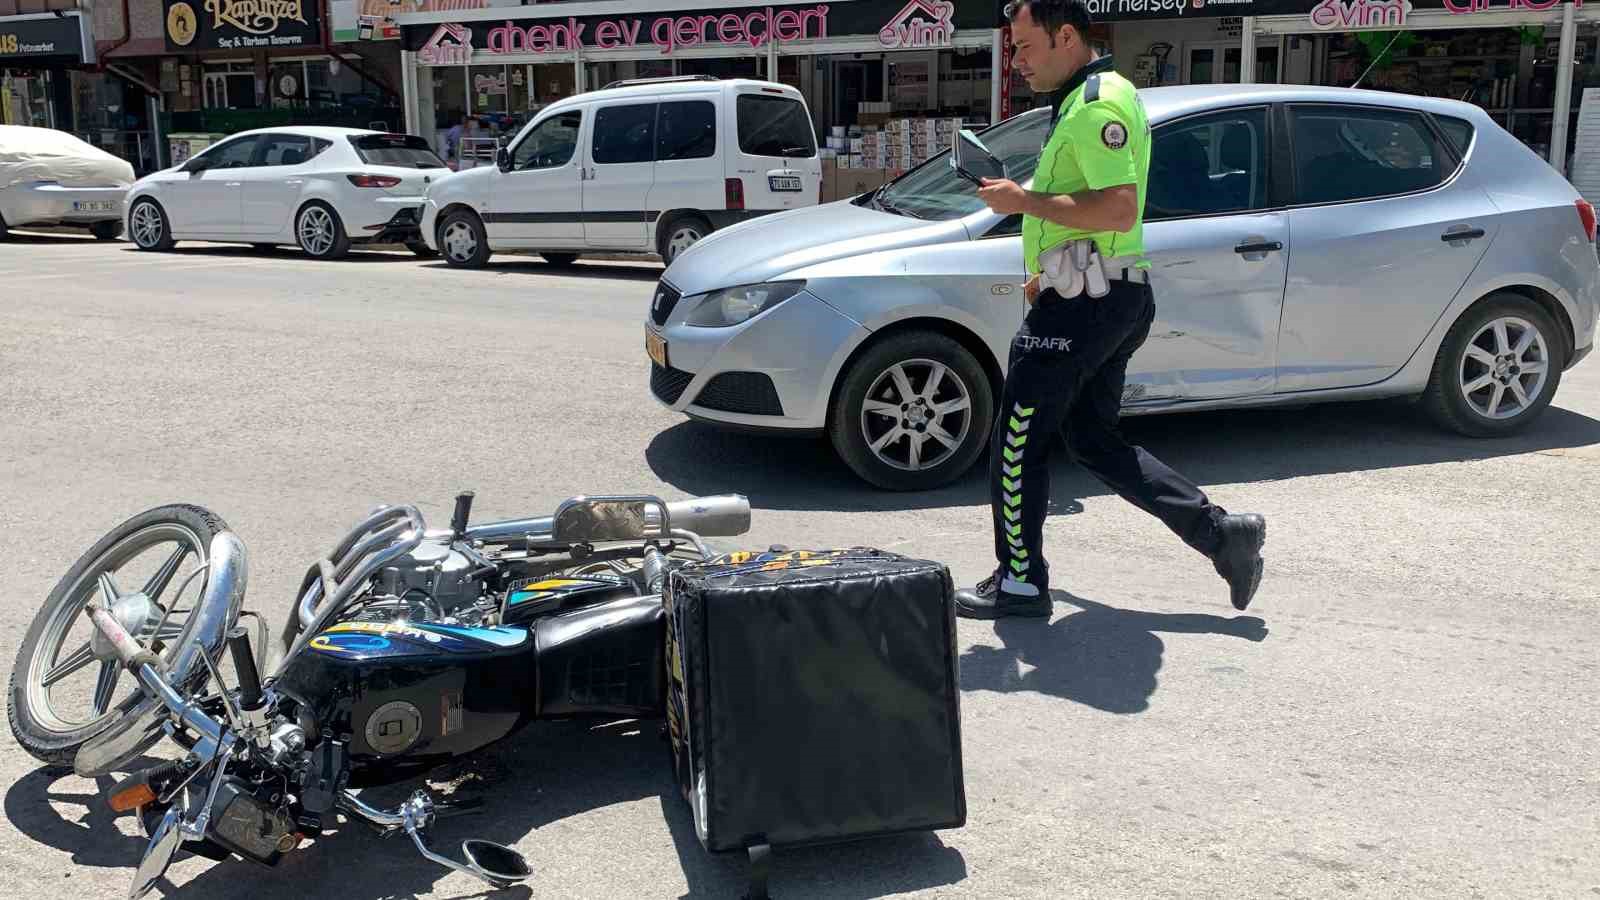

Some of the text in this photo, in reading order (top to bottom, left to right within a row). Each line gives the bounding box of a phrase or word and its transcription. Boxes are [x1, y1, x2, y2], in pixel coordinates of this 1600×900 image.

[204, 0, 308, 34] Rapunzel
[487, 5, 830, 54] ahenk ev gereçleri
[879, 18, 951, 48] evim
